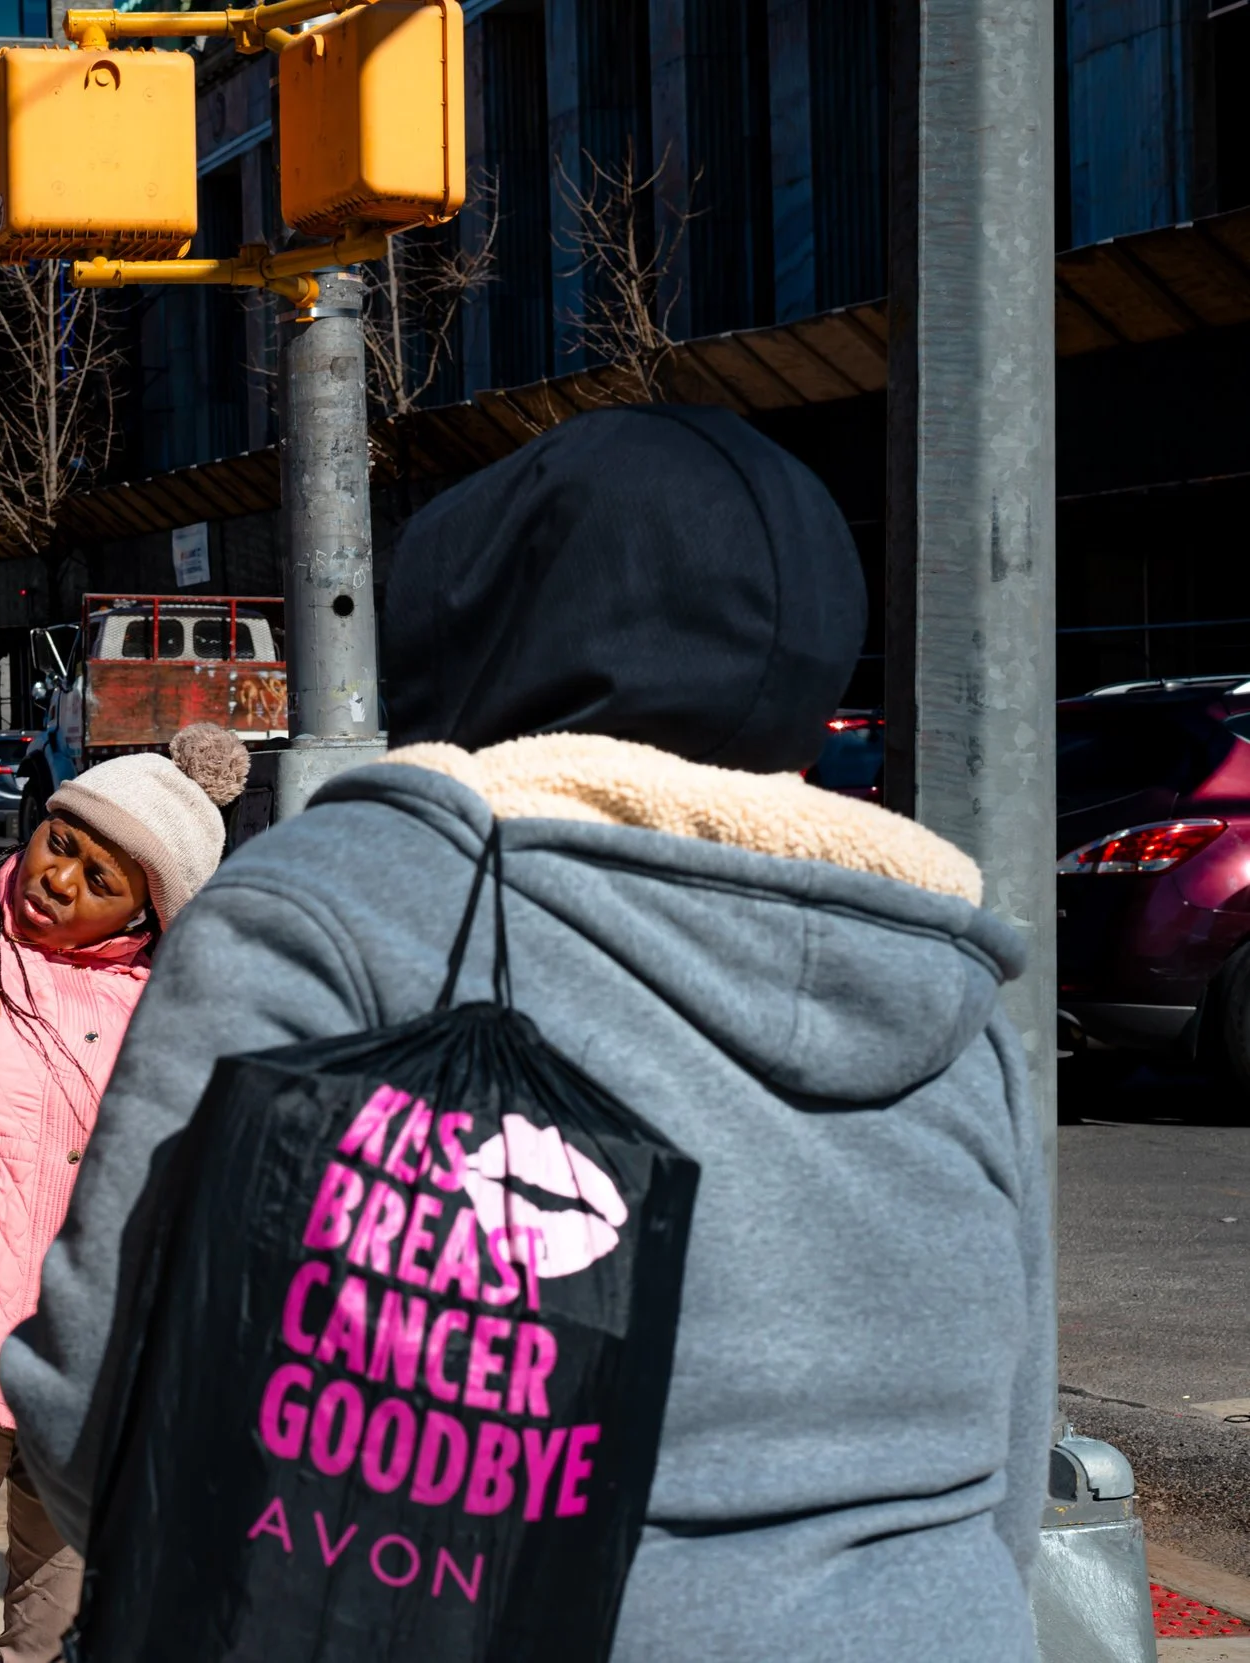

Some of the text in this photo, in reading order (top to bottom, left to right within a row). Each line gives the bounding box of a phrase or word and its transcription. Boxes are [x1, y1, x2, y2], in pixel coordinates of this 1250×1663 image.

[303, 1160, 544, 1311] BREAST
[282, 1260, 558, 1418] CANCER
[259, 1362, 601, 1523] GOODBYE
[247, 1497, 485, 1604] AVON
